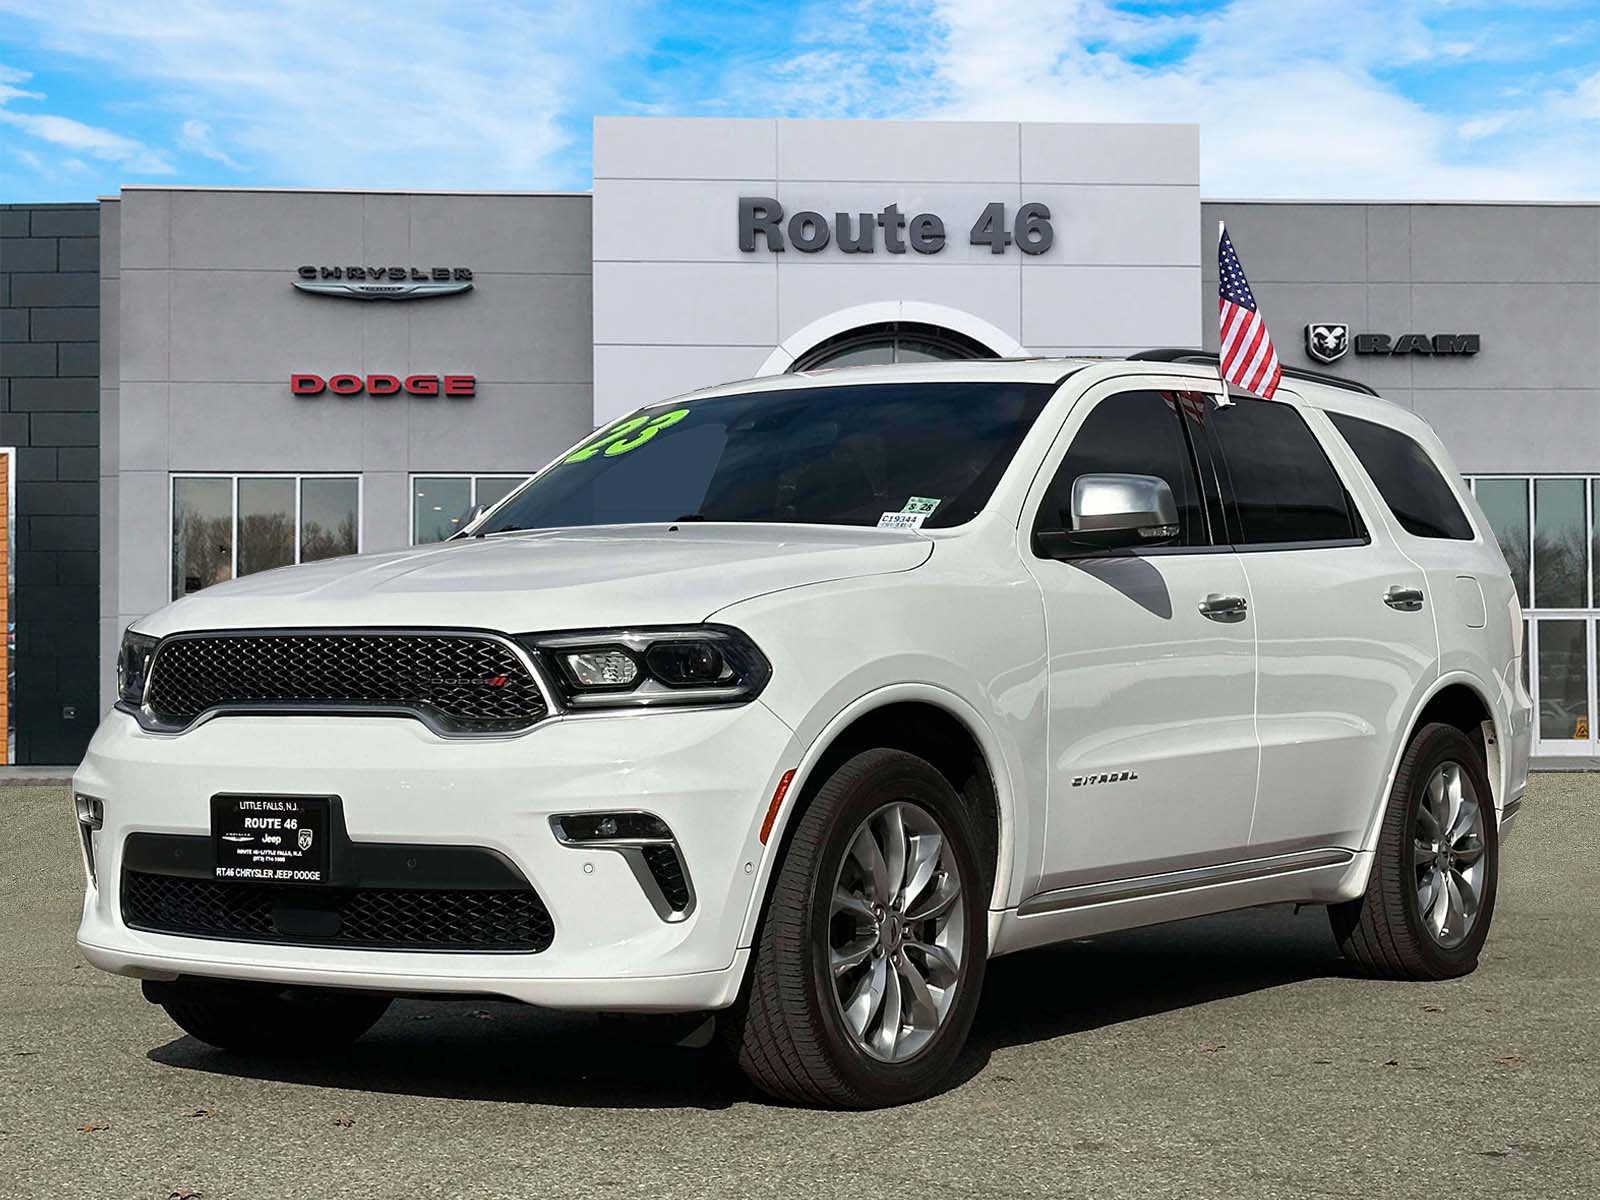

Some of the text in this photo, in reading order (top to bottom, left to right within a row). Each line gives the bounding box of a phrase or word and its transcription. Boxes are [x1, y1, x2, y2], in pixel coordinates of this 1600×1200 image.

[738, 197, 1054, 256] Route 46
[299, 265, 473, 281] CHRYSLER
[1354, 334, 1481, 356] RAM
[290, 374, 477, 397] DODGE
[562, 409, 690, 464] 23
[881, 515, 918, 523] C19344
[1072, 771, 1138, 787] CITADEL
[239, 801, 262, 810] LITTLE
[262, 802, 285, 812] FALLS,
[244, 818, 298, 830] ROUTE 46
[261, 833, 282, 845] Jeep
[235, 868, 274, 879] CHRYSLER
[274, 869, 294, 879] JEEP
[293, 870, 321, 881] DODGE
